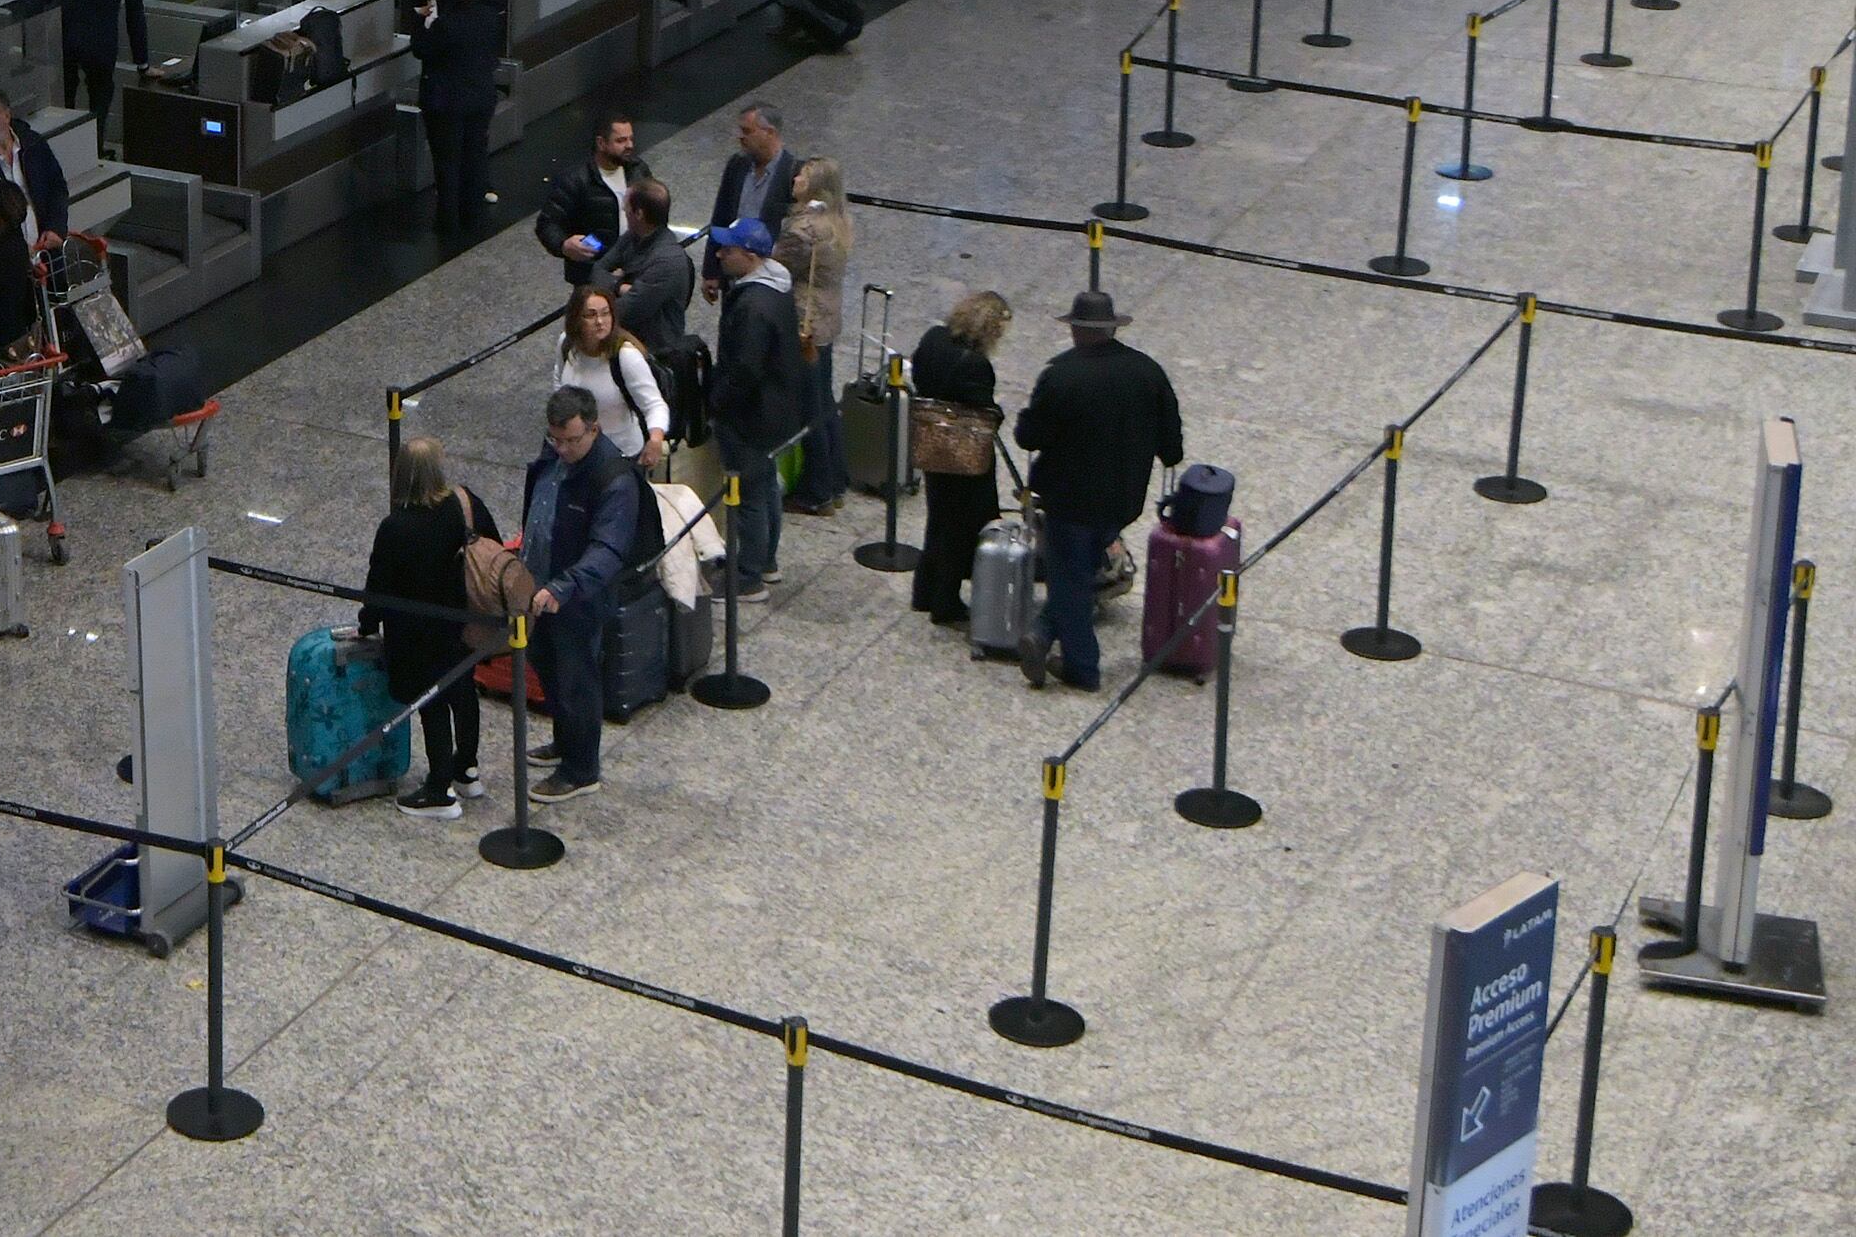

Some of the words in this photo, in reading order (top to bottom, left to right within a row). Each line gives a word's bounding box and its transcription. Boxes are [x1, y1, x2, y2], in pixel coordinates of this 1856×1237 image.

[1512, 908, 1554, 940] LATAM
[1467, 980, 1543, 1041] Premium
[1470, 963, 1528, 1013] Acceso
[1465, 1029, 1505, 1062] Premium
[1505, 1011, 1535, 1035] Access
[1450, 1168, 1526, 1229] Atenciones
